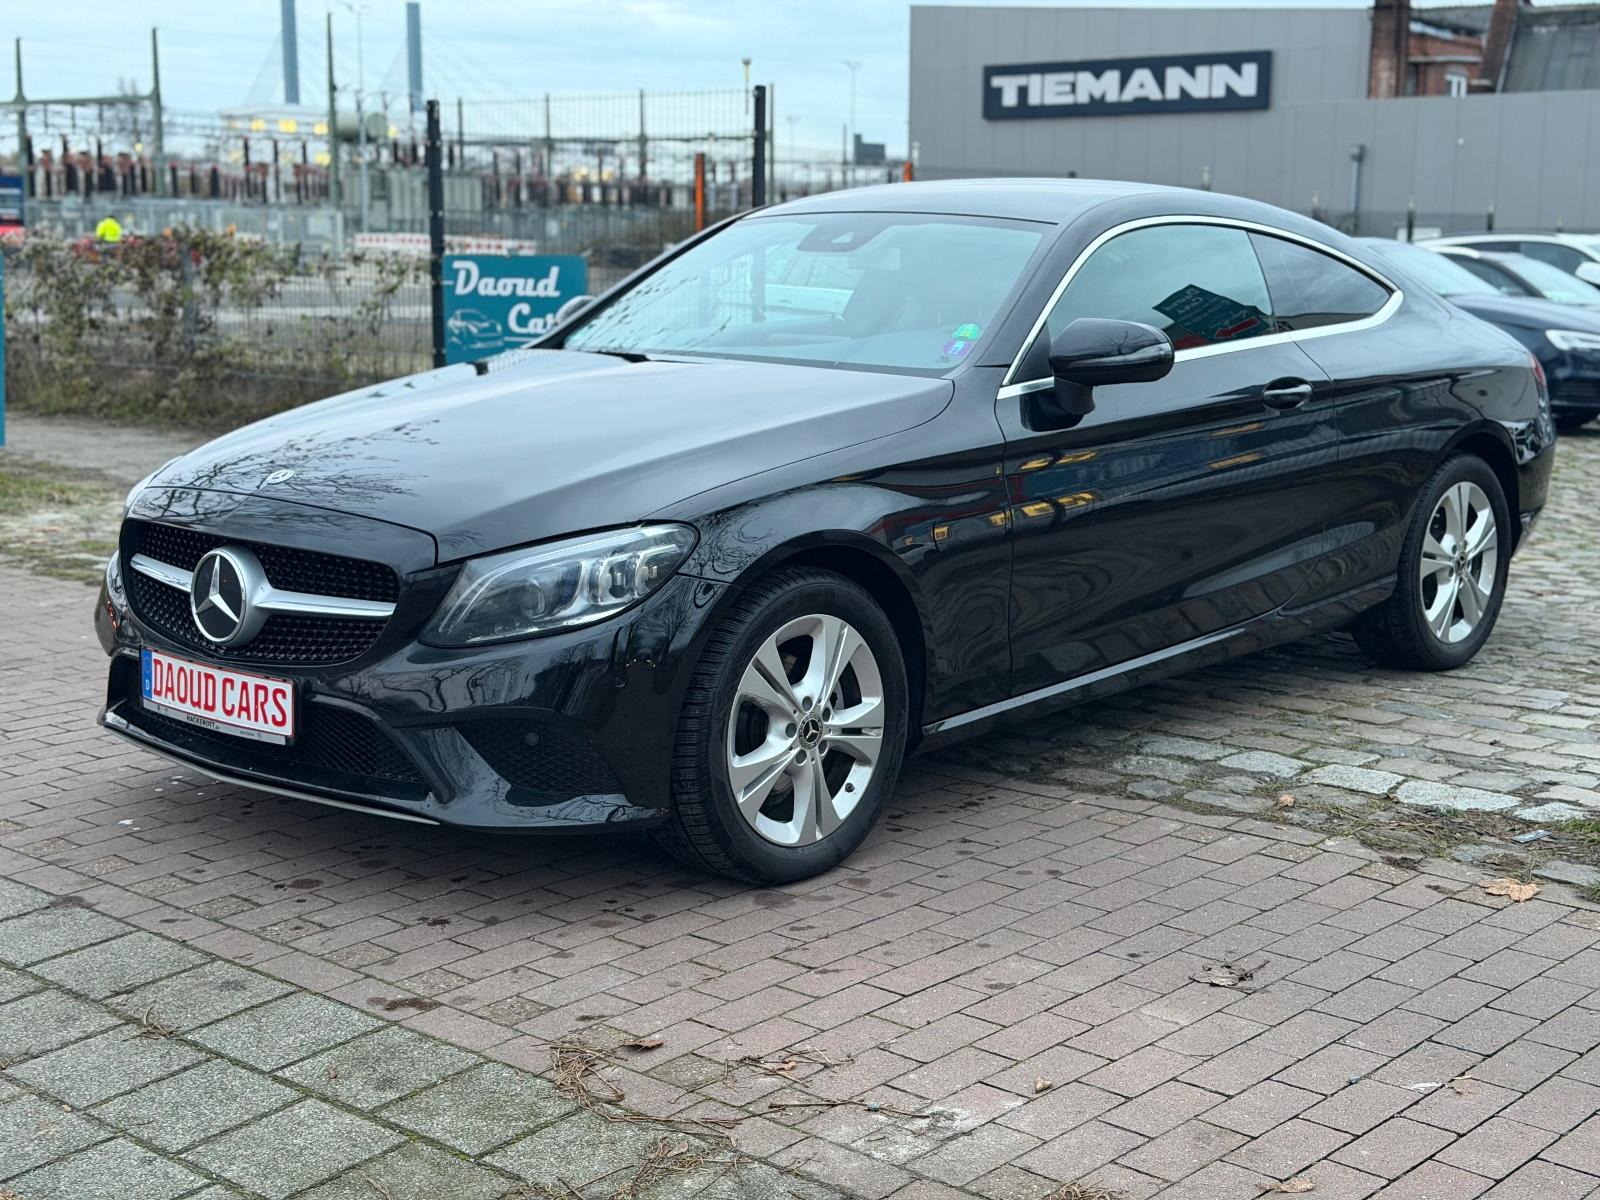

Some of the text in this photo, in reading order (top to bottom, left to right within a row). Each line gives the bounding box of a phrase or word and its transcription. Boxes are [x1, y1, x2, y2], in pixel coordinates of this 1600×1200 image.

[991, 62, 1258, 107] TIEMANN
[452, 260, 560, 297] Daoud
[508, 302, 556, 334] Car
[153, 658, 287, 727] DAOUD CARS
